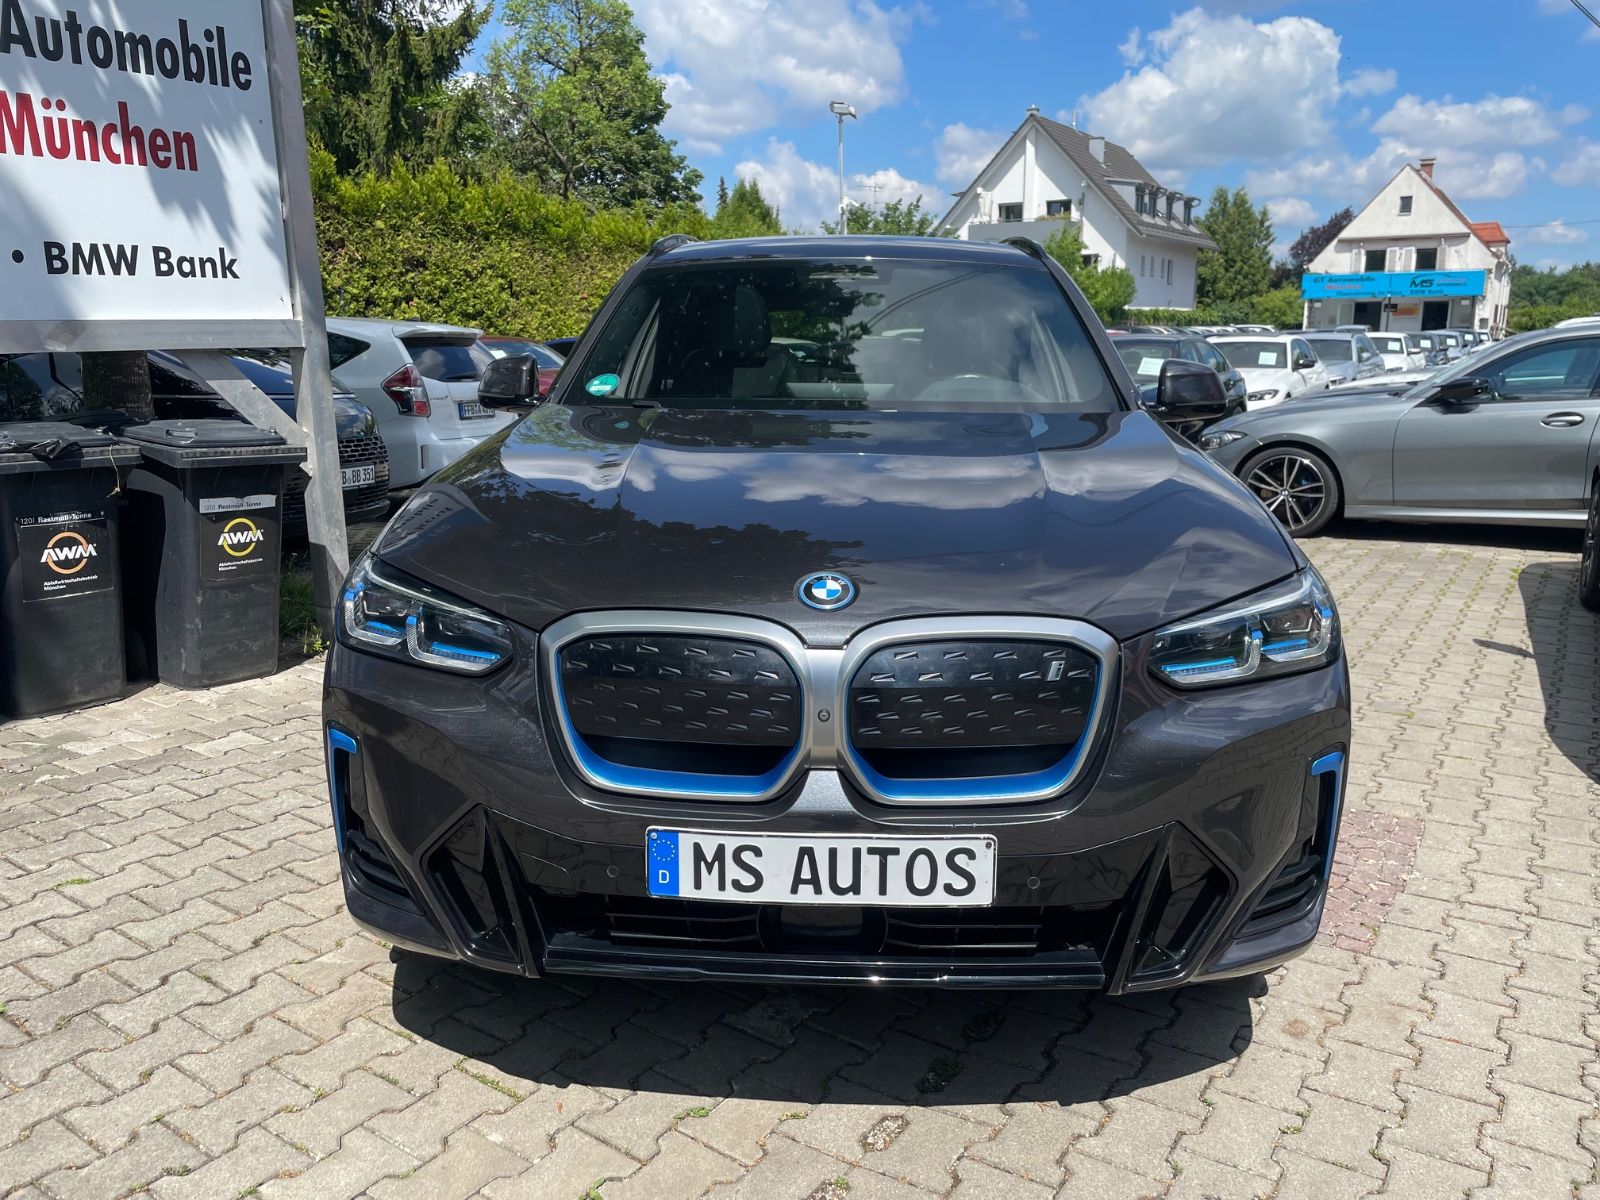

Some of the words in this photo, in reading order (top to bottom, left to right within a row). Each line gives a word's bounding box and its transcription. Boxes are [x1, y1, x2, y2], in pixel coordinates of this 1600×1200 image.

[0, 0, 252, 91] Automobile
[0, 90, 199, 172] München
[43, 241, 139, 276] BMW
[152, 246, 240, 279] Bank
[362, 467, 375, 482] 351
[40, 543, 98, 563] AWM
[217, 529, 264, 545] AWM
[658, 869, 670, 884] D
[692, 841, 764, 893] MS
[790, 844, 977, 897] AUTOS
